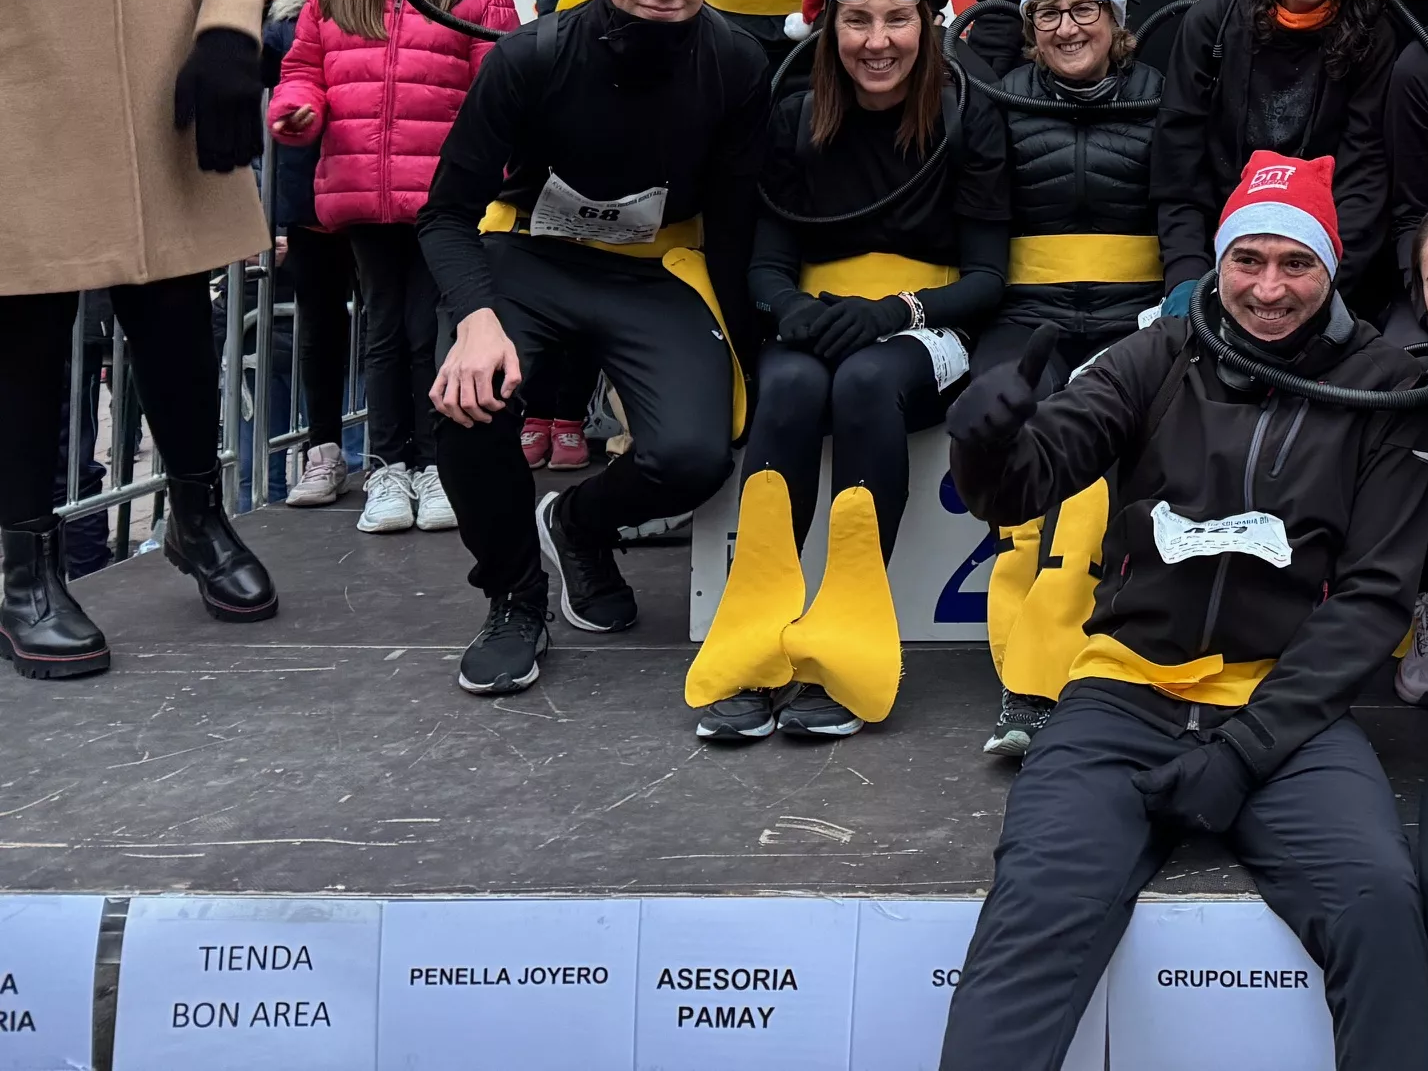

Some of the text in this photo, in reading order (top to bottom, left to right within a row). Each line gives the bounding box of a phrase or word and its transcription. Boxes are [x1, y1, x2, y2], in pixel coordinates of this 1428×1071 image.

[1250, 166, 1297, 186] bnf
[578, 205, 621, 222] 68
[199, 945, 313, 972] TIENDA
[410, 966, 609, 986] PENELLA JOYERO
[656, 967, 798, 991] ASESORIA
[1157, 969, 1309, 989] GRUPOLENER
[172, 1001, 331, 1028] BON AREA
[677, 1006, 776, 1029] PAMAY
